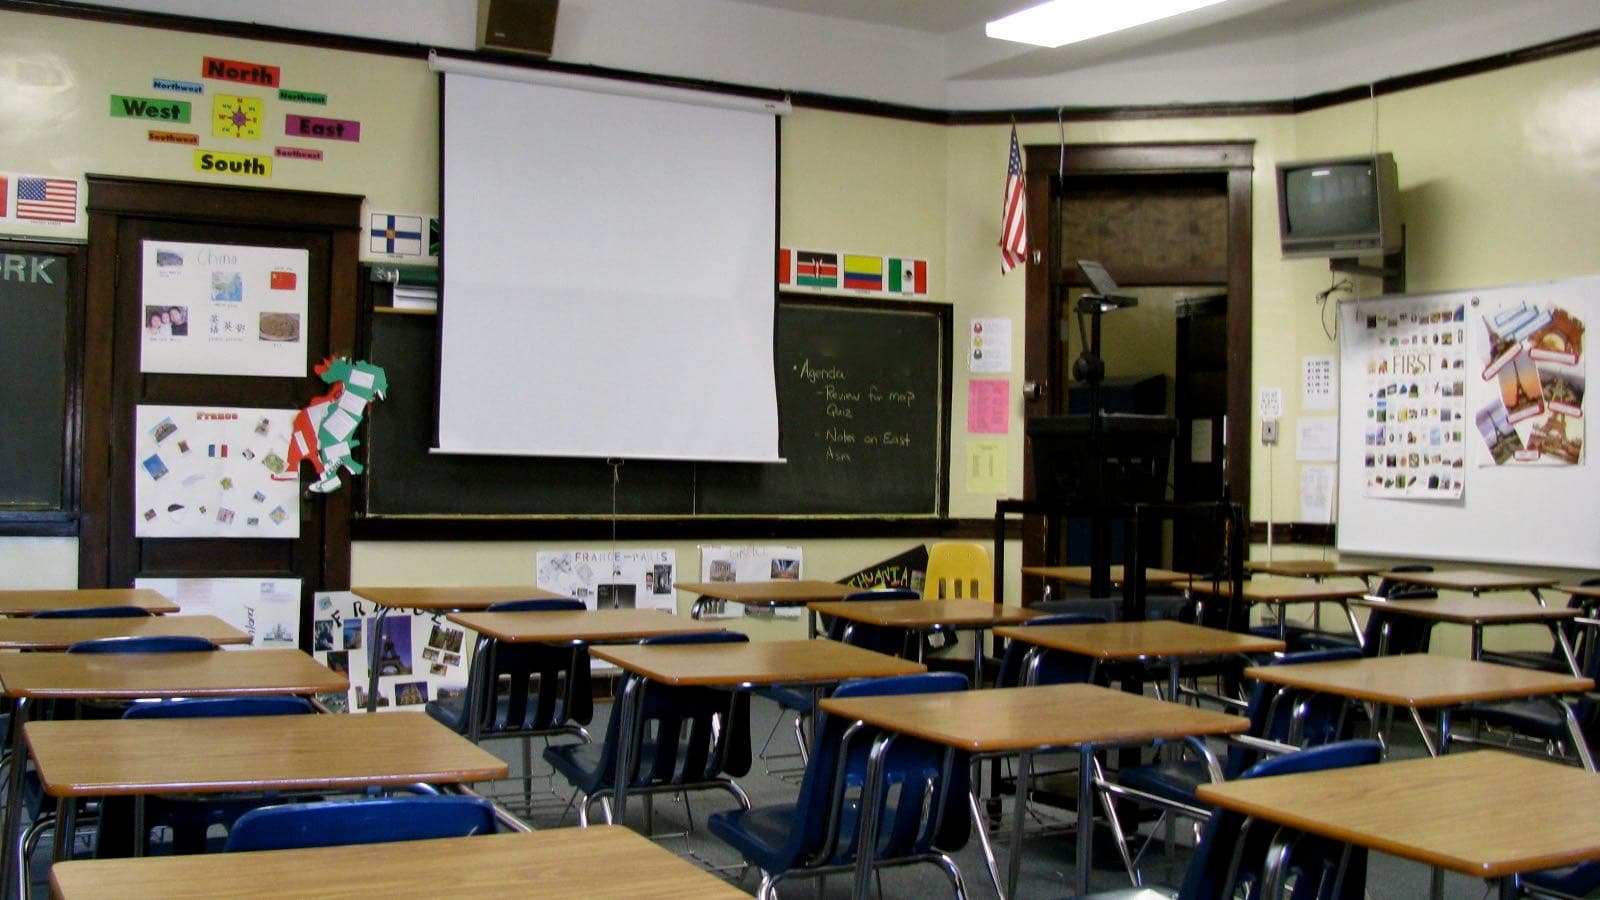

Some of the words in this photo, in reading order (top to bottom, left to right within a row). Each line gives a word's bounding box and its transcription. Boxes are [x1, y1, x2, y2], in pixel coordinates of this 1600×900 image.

[207, 60, 274, 84] North
[153, 80, 203, 94] Northwest
[279, 91, 326, 104] Northeast
[122, 98, 181, 120] West
[299, 118, 345, 137] East
[148, 131, 198, 144] Southwest
[275, 148, 321, 160] Southeast
[200, 154, 266, 175] South
[197, 248, 237, 266] China
[0, 254, 55, 284] RK
[800, 358, 846, 384] Agenda
[1393, 353, 1432, 374] FIRST
[825, 384, 860, 401] Review
[869, 384, 883, 402] for
[196, 412, 239, 421] France
[826, 403, 853, 418] Quiz
[825, 426, 856, 443] Notes
[864, 435, 878, 444] on
[882, 431, 911, 447] East
[847, 565, 909, 590] THUANIA
